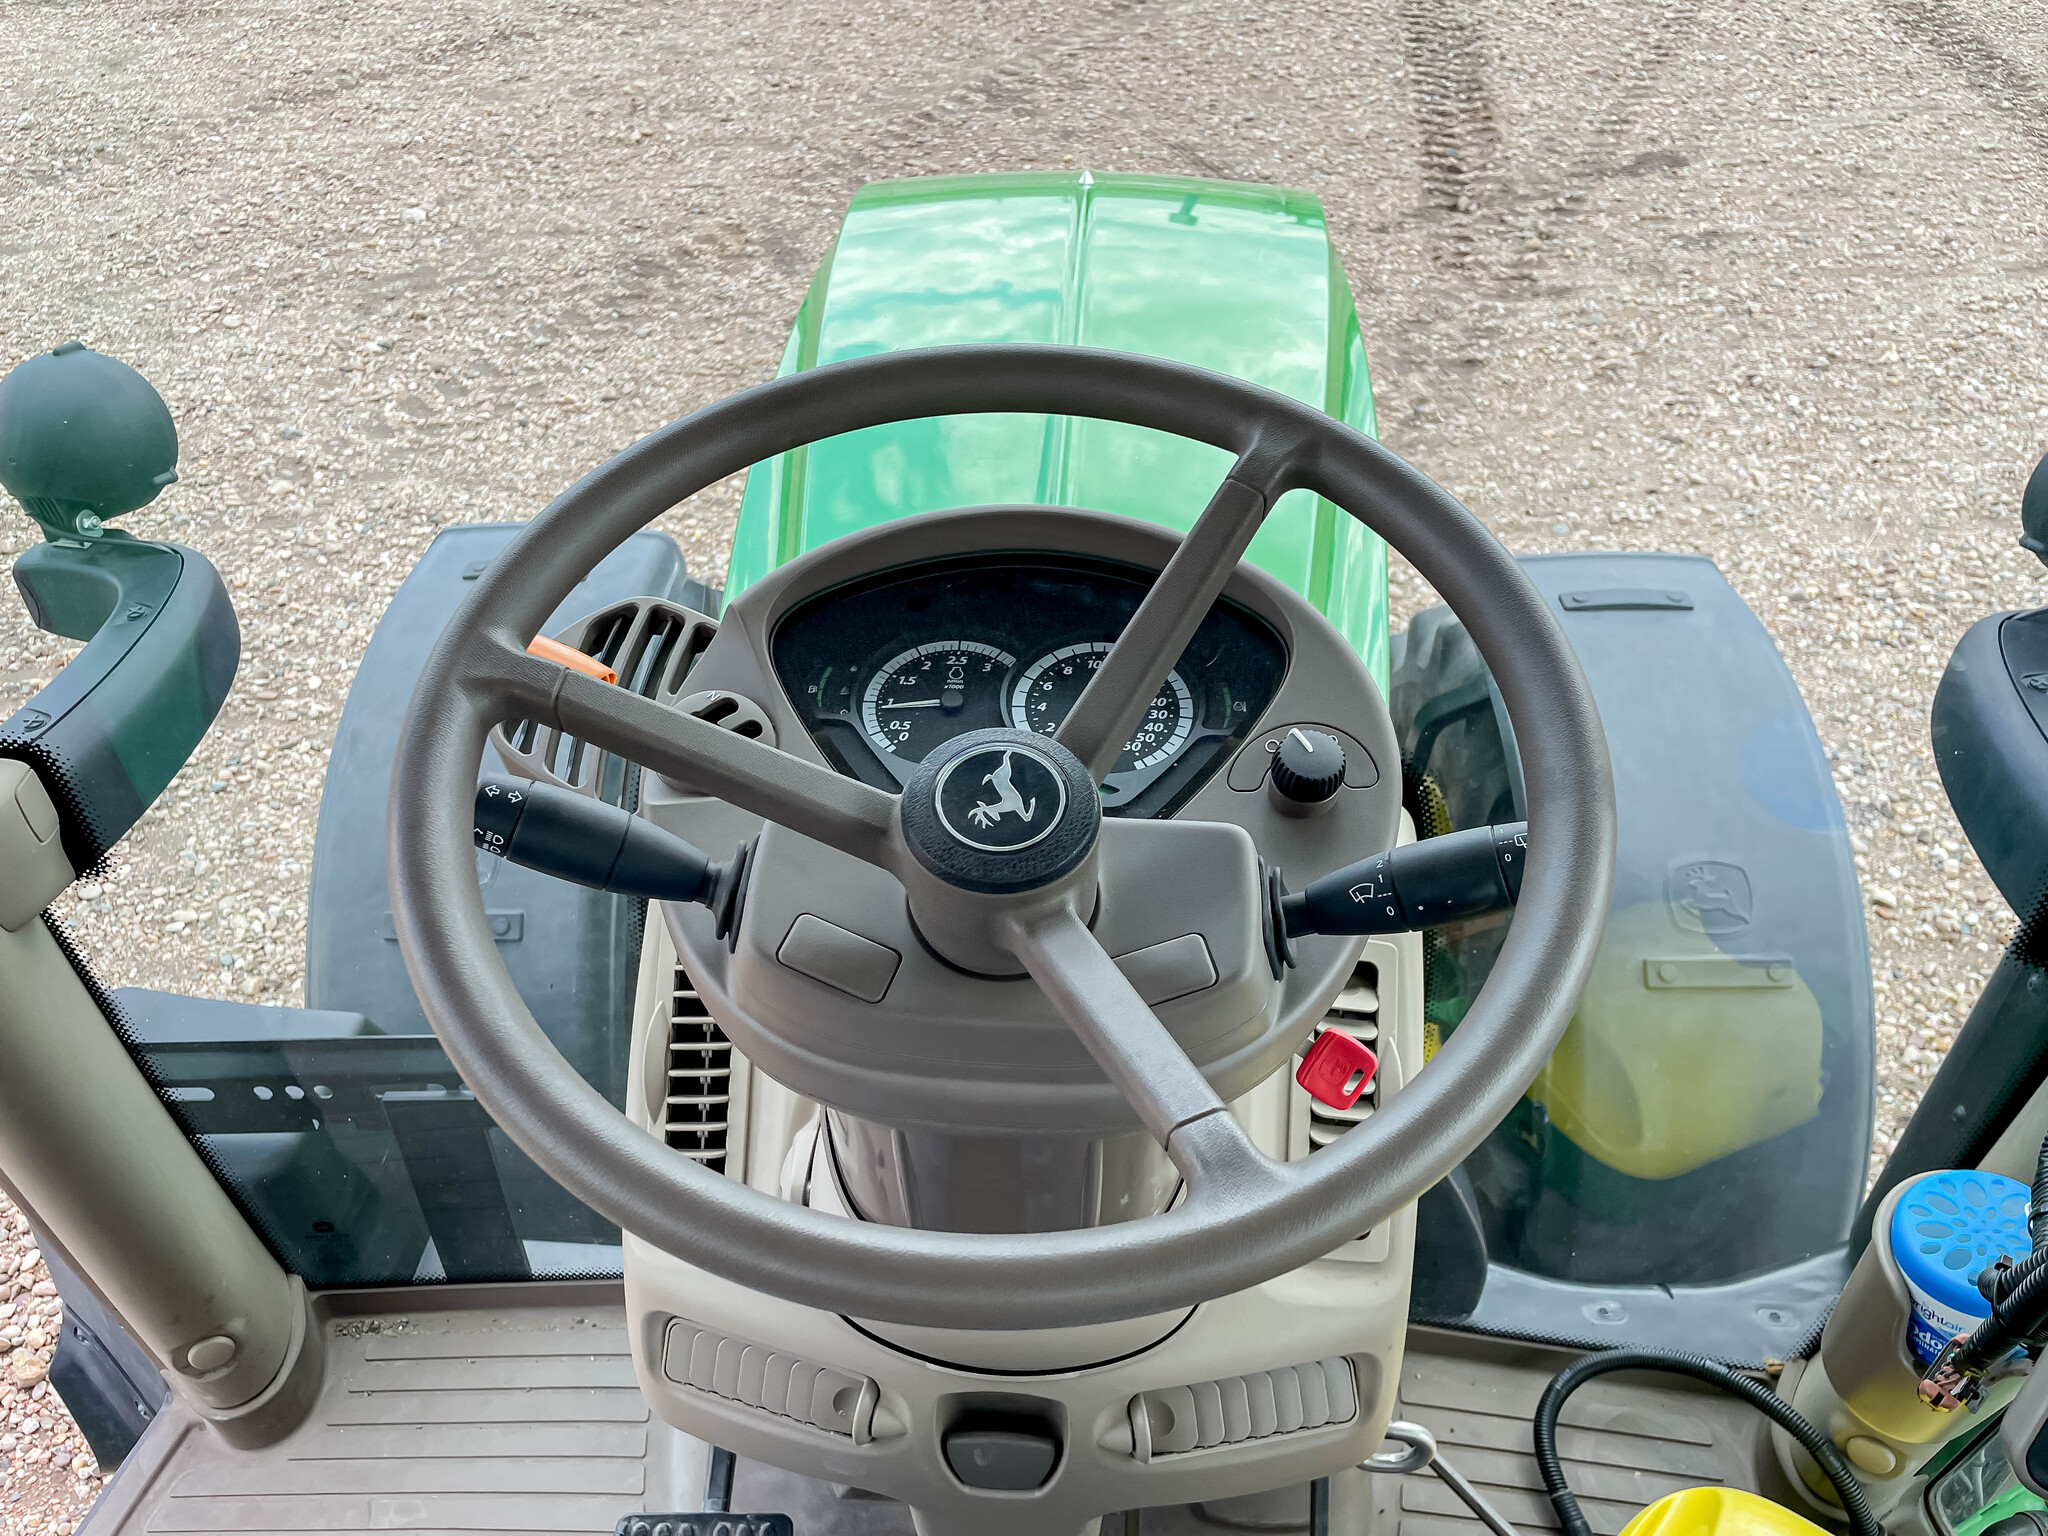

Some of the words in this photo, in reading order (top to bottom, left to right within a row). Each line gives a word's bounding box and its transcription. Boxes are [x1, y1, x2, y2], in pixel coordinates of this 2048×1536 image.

[946, 656, 968, 665] 2.5
[1087, 660, 1103, 669] 10
[921, 661, 932, 670] 2
[982, 663, 992, 672] 3
[1062, 666, 1073, 675] 8
[899, 676, 918, 685] 1.5
[1043, 681, 1053, 691] 6
[887, 698, 894, 706] 1
[1150, 697, 1167, 707] 20
[1036, 702, 1047, 712] 4
[1148, 709, 1168, 719] 30
[889, 720, 911, 730] 0.5
[1044, 722, 1056, 732] 2
[1143, 722, 1164, 732] 40
[898, 732, 909, 741] 0
[1135, 732, 1155, 742] 50
[1504, 853, 1512, 862] 0
[1376, 859, 1384, 868] 2
[1377, 874, 1384, 883] 1
[1386, 906, 1395, 916] 0
